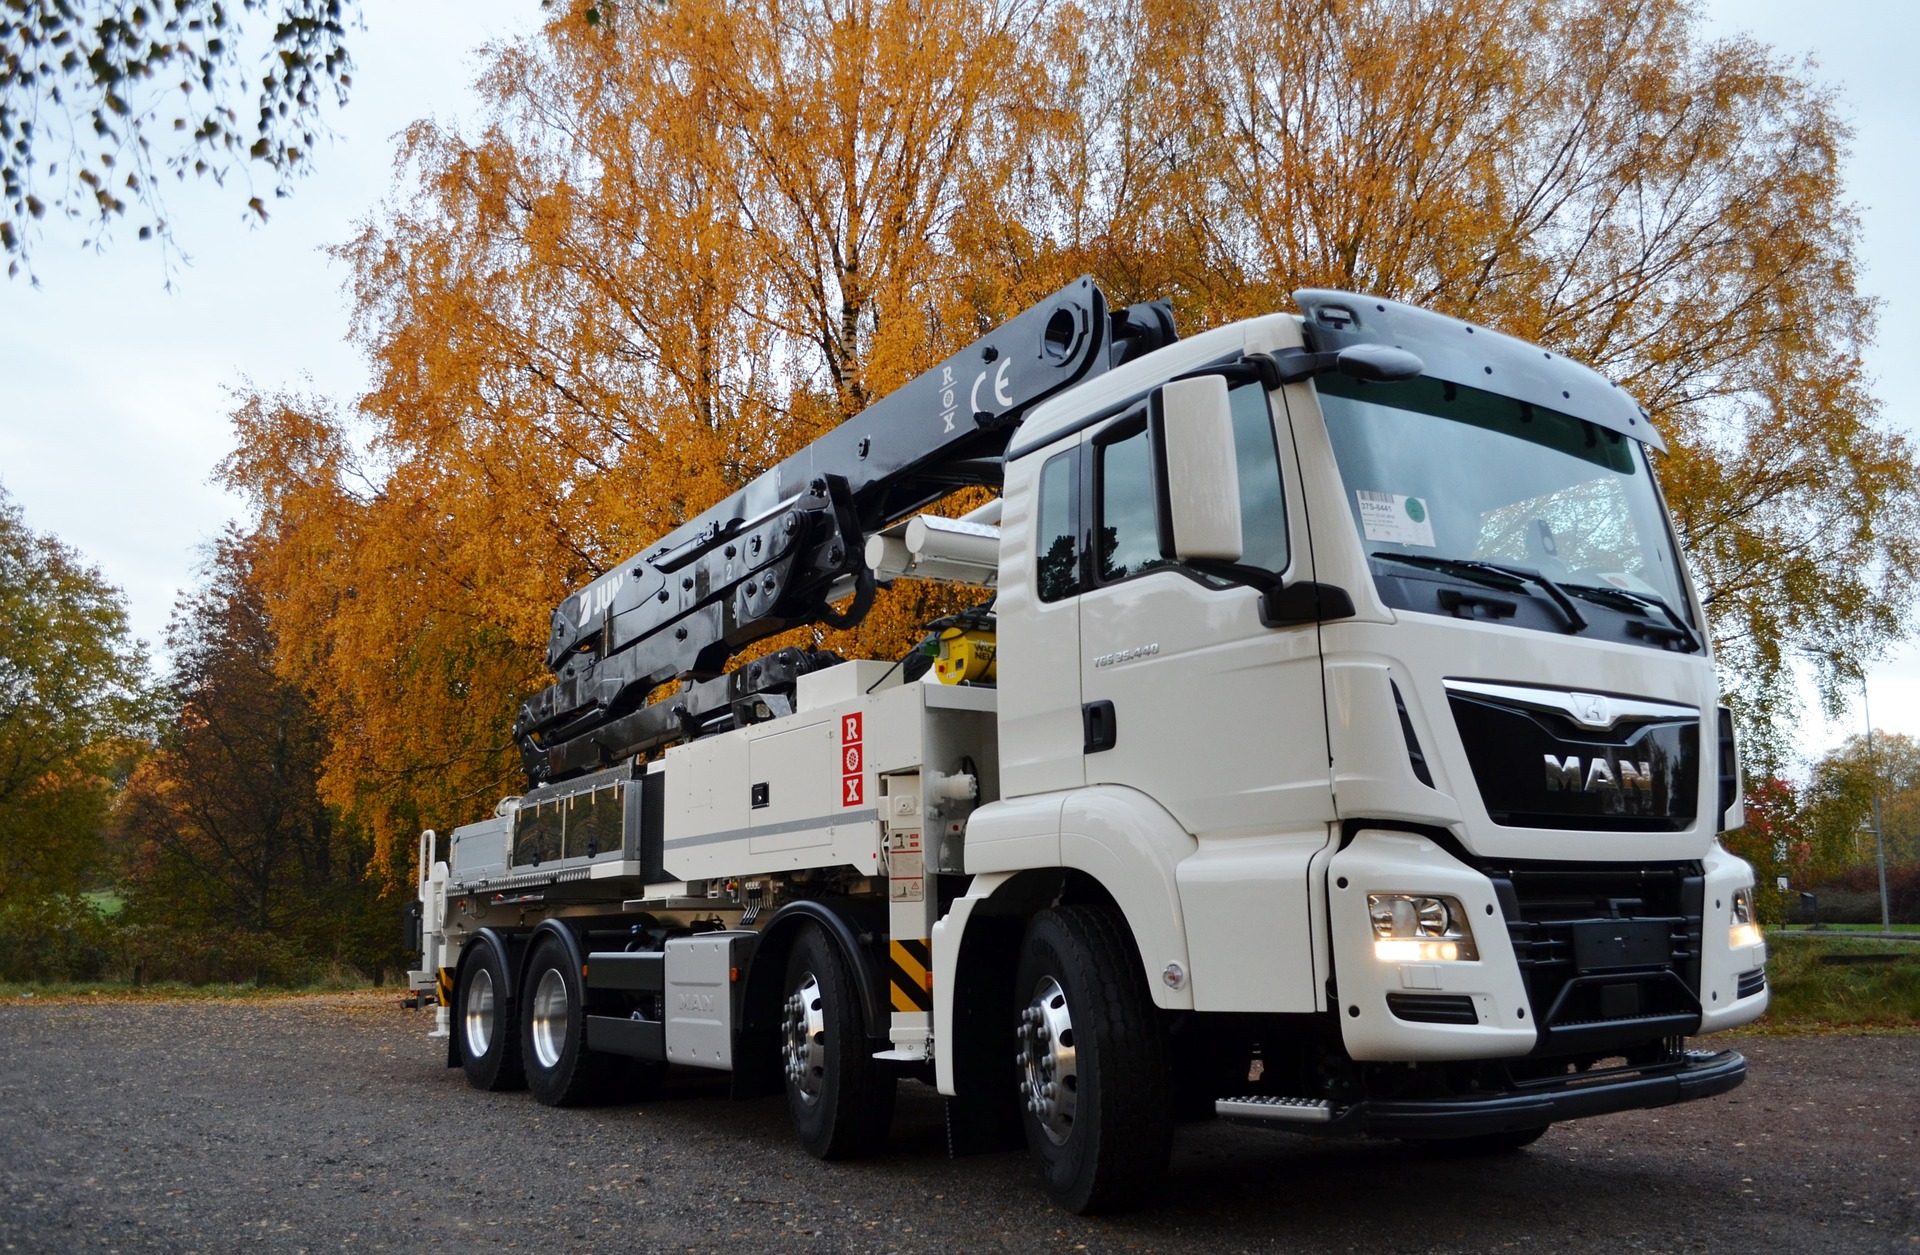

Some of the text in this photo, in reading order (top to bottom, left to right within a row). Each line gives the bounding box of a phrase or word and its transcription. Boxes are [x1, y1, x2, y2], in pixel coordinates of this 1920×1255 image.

[726, 563, 733, 581] 2
[594, 569, 631, 616] JUN
[731, 600, 737, 620] 3
[974, 643, 997, 653] WAC
[1115, 643, 1160, 662] 35.440
[735, 674, 742, 692] 4
[845, 717, 859, 803] ROX
[1543, 754, 1652, 792] MAN
[678, 993, 714, 1011] MAN
